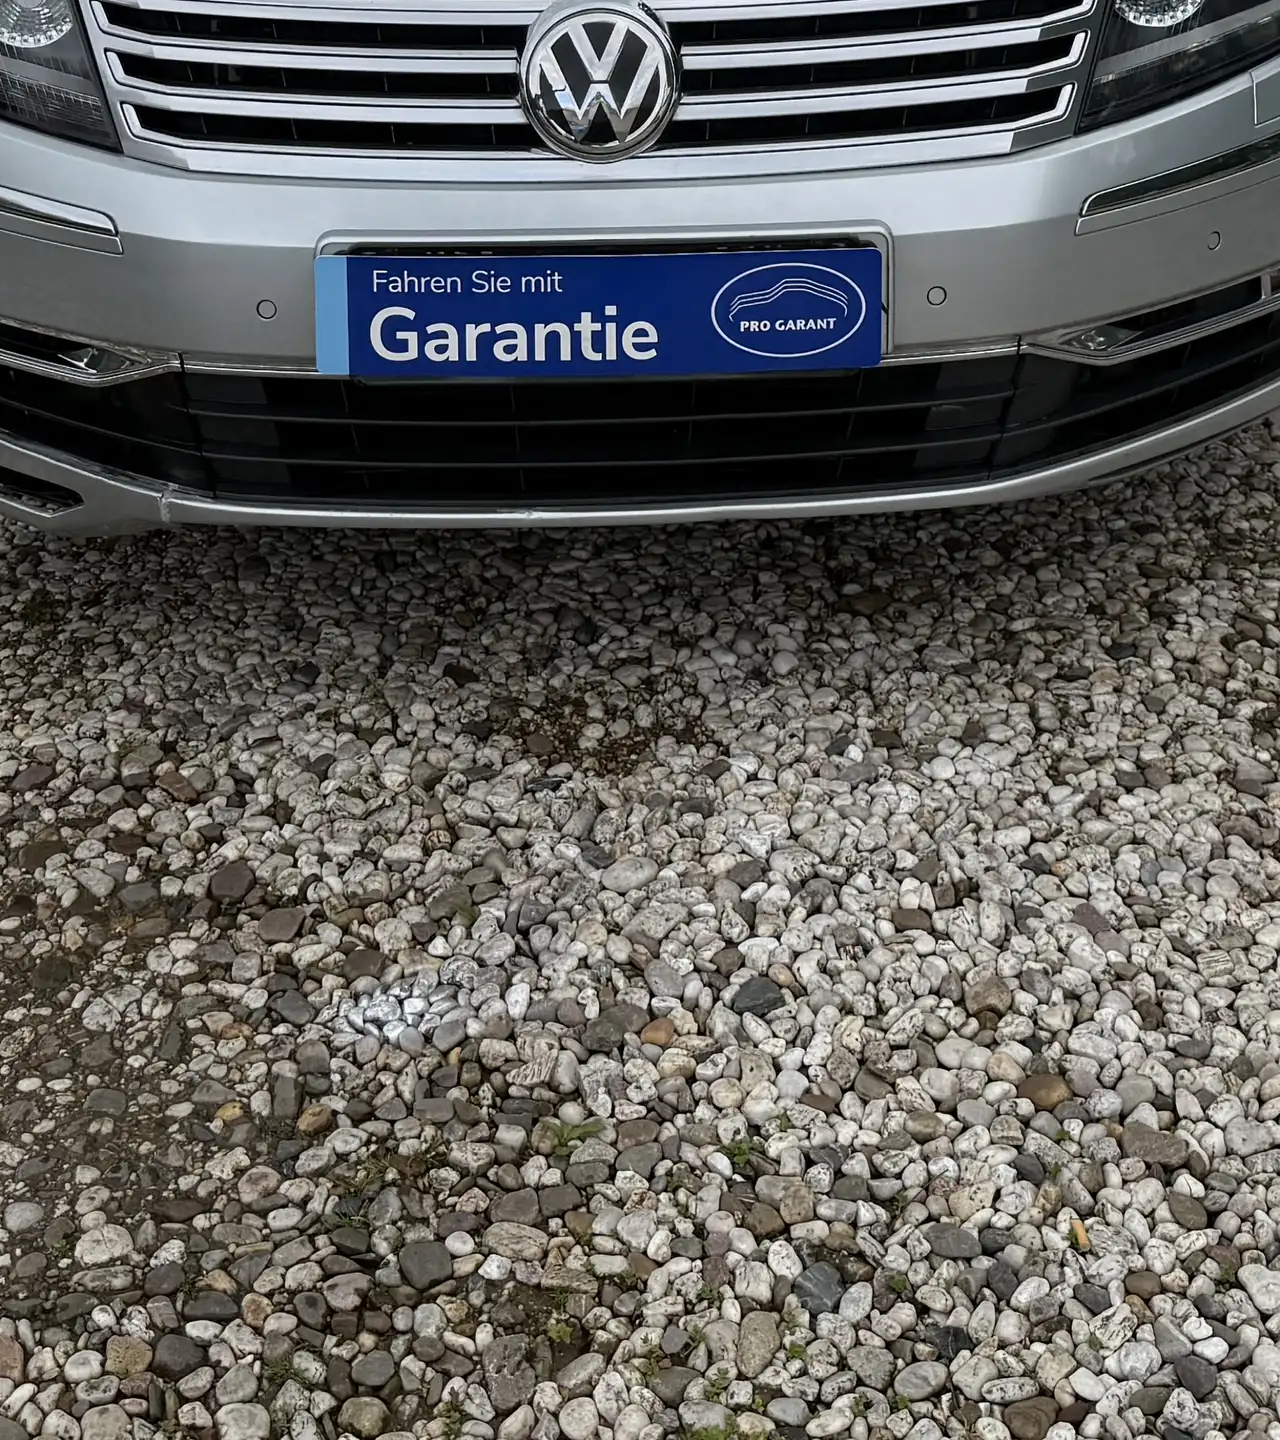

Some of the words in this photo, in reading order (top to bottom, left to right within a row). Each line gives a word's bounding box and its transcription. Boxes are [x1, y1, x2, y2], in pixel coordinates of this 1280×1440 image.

[532, 12, 668, 153] VW
[372, 270, 462, 293] Fahren
[471, 270, 512, 293] Sie
[521, 270, 563, 293] mit
[370, 305, 659, 362] Garantie
[740, 320, 771, 332] PRO
[775, 318, 837, 331] GARANT
